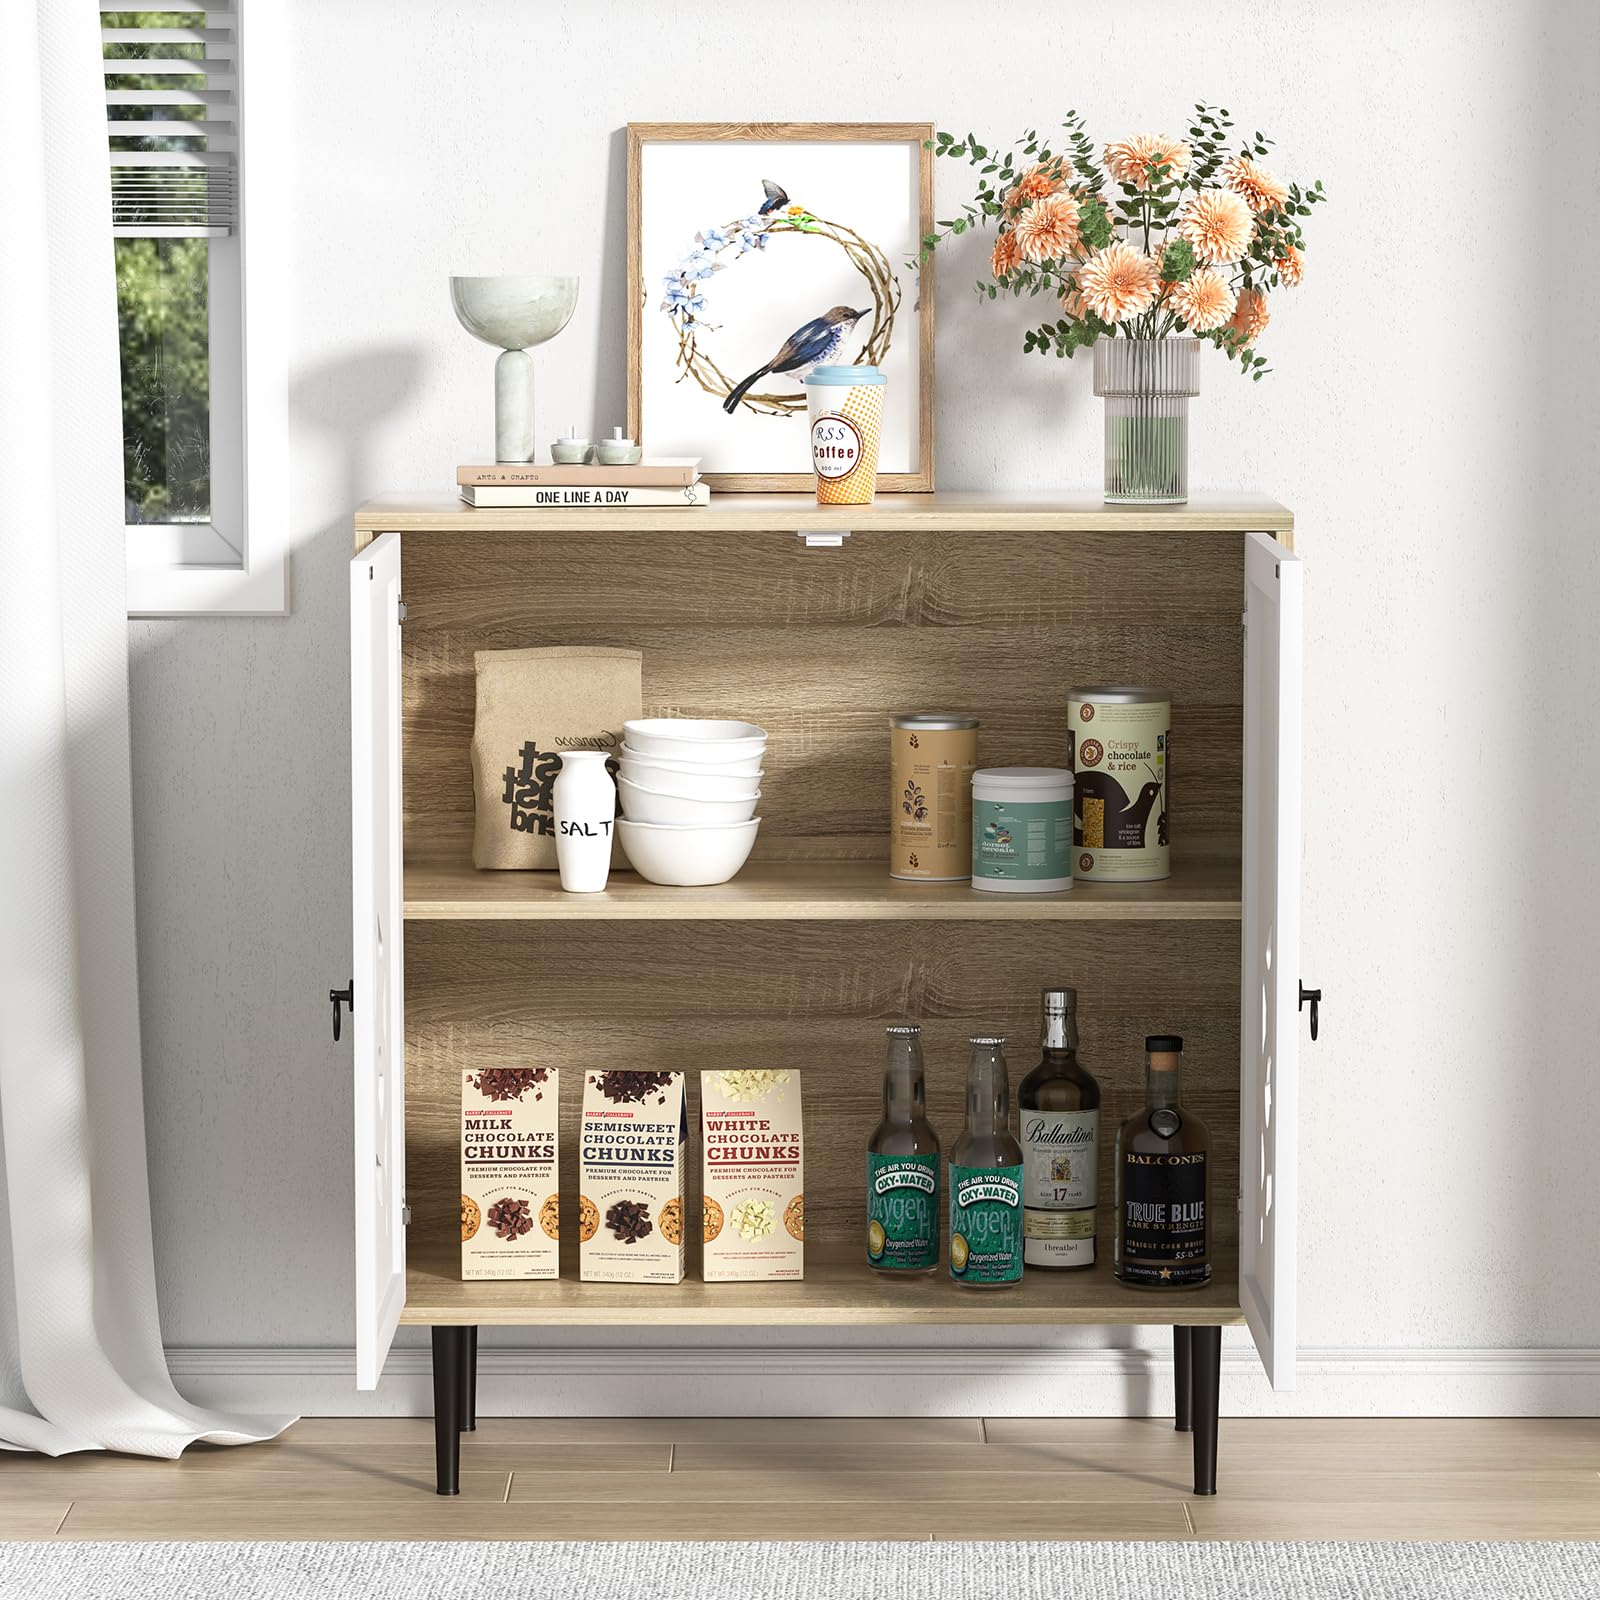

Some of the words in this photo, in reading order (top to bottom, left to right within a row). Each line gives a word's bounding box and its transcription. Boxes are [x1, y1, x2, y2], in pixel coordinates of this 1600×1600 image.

[813, 445, 854, 458] Coffee
[536, 491, 560, 503] ONE
[564, 491, 590, 503] LINE
[594, 491, 602, 502] A
[606, 491, 628, 502] DAY
[1108, 740, 1139, 750] Crispy
[1107, 751, 1151, 760] chocolate
[1107, 762, 1115, 770] &
[1118, 762, 1136, 770] rice
[560, 820, 612, 836] SALT
[465, 1119, 512, 1130] MILK
[584, 1122, 675, 1133] SEMISWEET
[706, 1120, 770, 1131] WHITE
[464, 1133, 554, 1142] CHOCOLATE
[583, 1135, 675, 1146] CHOCOLATE
[707, 1133, 800, 1144] CHOCOLATE
[464, 1145, 554, 1159] CHUNKS
[583, 1147, 674, 1162] CHUNKS
[707, 1146, 800, 1160] CHUNKS
[1127, 1153, 1204, 1166] BALCONES
[875, 1166, 887, 1178] THE
[887, 1164, 900, 1172] AIR
[917, 1163, 935, 1178] DRINK
[958, 1179, 970, 1190] THE
[971, 1176, 983, 1185] AIR
[1001, 1177, 1019, 1190] DRINK
[1053, 1188, 1067, 1201] 17
[1126, 1200, 1166, 1223] TRUE
[1171, 1201, 1204, 1222] BLUE
[1126, 1221, 1149, 1229] CASK
